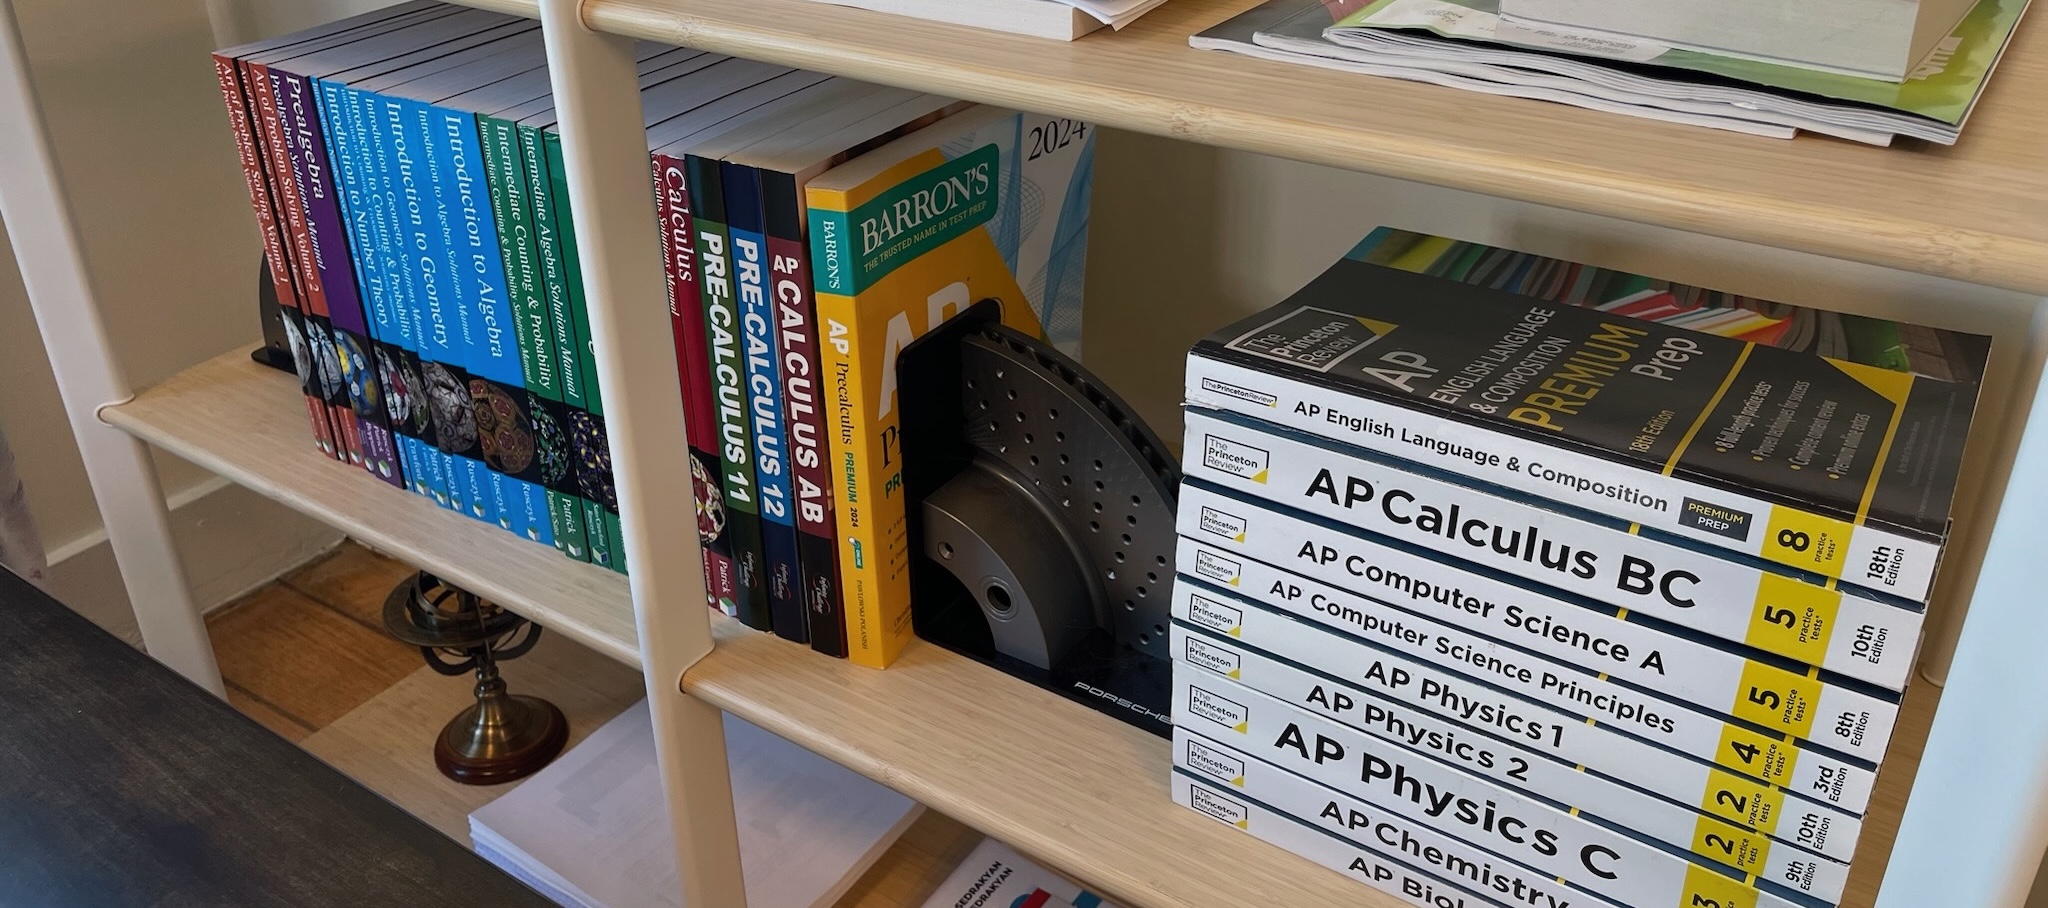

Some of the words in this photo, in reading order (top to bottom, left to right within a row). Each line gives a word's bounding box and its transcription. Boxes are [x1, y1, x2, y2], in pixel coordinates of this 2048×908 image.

[221, 63, 235, 87] Art
[254, 69, 266, 93] Art
[230, 90, 241, 107] of
[261, 97, 274, 114] of
[235, 109, 255, 166] Problem
[266, 116, 287, 173] Problem
[285, 75, 324, 199] Prealgebra
[326, 86, 356, 185] Introduction
[348, 90, 374, 174] Introduction
[418, 109, 439, 183] Introduction
[1027, 118, 1088, 162] 2024
[270, 74, 294, 149] Prealgebra
[289, 152, 311, 216] Solutions
[306, 218, 326, 270] Manual
[368, 177, 377, 191] to
[386, 101, 422, 226] Introduction
[445, 115, 481, 247] Introduction
[497, 124, 520, 221] Intermediate
[251, 170, 270, 220] Solving
[282, 177, 301, 228] Solving
[349, 190, 360, 206] to
[434, 185, 442, 198] to
[652, 160, 664, 213] Calculus
[859, 161, 989, 256] BARRON'S
[354, 210, 377, 273] Number
[365, 98, 387, 173] Introduction
[383, 176, 391, 188] to
[387, 190, 404, 249] Geometry
[400, 251, 416, 305] Solutions
[412, 306, 428, 350] Manual
[372, 194, 390, 253] Counting
[414, 232, 427, 251] to
[437, 200, 452, 245] Algebra
[658, 215, 673, 270] Solutions
[666, 166, 694, 282] Calculus
[864, 256, 879, 273] THE
[879, 239, 912, 263] TRUSTED
[913, 224, 937, 245] NAME
[938, 219, 948, 232] IN
[949, 209, 968, 227] TEST
[968, 200, 987, 218] PREP
[267, 225, 284, 272] Volume
[297, 232, 314, 280] Volume
[386, 257, 397, 269] &
[472, 254, 486, 274] to
[480, 121, 497, 185] Intermediate
[492, 187, 505, 233] Counting
[503, 248, 518, 301] Probability
[513, 301, 526, 346] Solutions
[521, 347, 534, 384] Manual
[515, 225, 534, 292] Counting
[525, 131, 546, 221] Intermediate
[540, 223, 556, 279] Algebra
[550, 282, 568, 345] Solutions
[560, 346, 579, 398] Manual
[773, 254, 799, 275] AP
[823, 220, 841, 290] BARRON'S
[309, 283, 319, 292] 2
[446, 247, 463, 301] Solutions
[665, 271, 680, 317] Manual
[371, 276, 389, 328] Theory
[389, 273, 411, 340] Probability
[420, 256, 448, 349] Geometry
[457, 302, 474, 346] Manual
[478, 278, 502, 358] Algebra
[527, 295, 539, 310] &
[530, 314, 552, 390] Probability
[827, 318, 850, 356] AP
[1243, 332, 1282, 350] The
[1270, 321, 1350, 359] Princeton
[1299, 335, 1358, 366] Review
[1428, 355, 1499, 404] ENGLISH
[1489, 306, 1556, 363] LANGUAGE
[1629, 337, 1704, 382] Prep
[700, 231, 747, 465] PRE-CALCULUS
[728, 471, 750, 503] 11
[736, 237, 780, 477] PRE-CALCULUS
[762, 484, 785, 518] 12
[1361, 350, 1440, 394] AP
[1481, 335, 1572, 403] COMPOSITION
[1506, 322, 1649, 432] PREMIUM
[777, 279, 819, 469] CALCULUS
[798, 475, 823, 523] AB
[836, 361, 855, 446] Precalculus
[1469, 402, 1499, 414] &
[1642, 410, 1676, 436] Edition
[1207, 456, 1242, 473] Review
[1208, 447, 1258, 469] Princeton
[1209, 438, 1228, 450] The
[1293, 400, 1321, 418] AP
[1326, 409, 1395, 439] English
[1401, 427, 1501, 468] Language
[1506, 456, 1521, 473] &
[1527, 461, 1669, 513] Composition
[1629, 435, 1657, 453] 18th
[844, 452, 858, 504] PREMIUM
[849, 507, 859, 528] 2024
[1688, 502, 1744, 525] PREMIUM
[1697, 516, 1730, 532] PREP
[1304, 467, 1375, 511] AP
[1381, 489, 1597, 581] Calculus
[1617, 554, 1702, 609] BC
[1777, 529, 1810, 552] 8
[1814, 532, 1828, 563] practice
[1866, 545, 1891, 580] 18th
[1884, 548, 1905, 587] Edition
[1297, 540, 1339, 566] AP
[1345, 554, 1495, 618] Computer
[1503, 604, 1630, 663] Science
[1639, 650, 1666, 676] A
[1763, 605, 1796, 630] 5
[1798, 606, 1815, 643] practice
[1269, 580, 1302, 601] AP
[1310, 593, 1428, 647] Computer
[1434, 636, 1533, 684] Science
[1540, 672, 1677, 735] Principles
[1851, 623, 1876, 659] 10th
[1868, 627, 1889, 664] Edition
[1074, 681, 1173, 726] PORSCHE
[1364, 660, 1411, 689] AP
[1419, 677, 1543, 740] Physics
[1551, 724, 1564, 749] 1
[1748, 686, 1780, 711] 5
[1782, 688, 1798, 725] practice
[1305, 684, 1354, 713] AP
[1364, 703, 1495, 770] Physics
[1506, 756, 1530, 783] 2
[1834, 711, 1856, 739] 8th
[1850, 711, 1870, 747] Edition
[1731, 740, 1761, 764] 4
[1762, 743, 1778, 779] practice
[1274, 722, 1346, 766] AP
[1360, 752, 1559, 857] Physics
[1579, 845, 1622, 880] C
[1716, 789, 1747, 814] 2
[1813, 765, 1834, 794] 3rd
[1828, 767, 1848, 802] Edition
[1704, 833, 1735, 856] 2
[1797, 812, 1819, 844] 10th
[1812, 817, 1831, 850] Edition
[1320, 800, 1369, 831] AP
[1375, 821, 1570, 908] Chemistry
[1349, 856, 1393, 883] AP
[1785, 860, 1804, 884] 9th
[1800, 861, 1817, 891] Edition
[954, 860, 1002, 908] SEDRAKYAN
